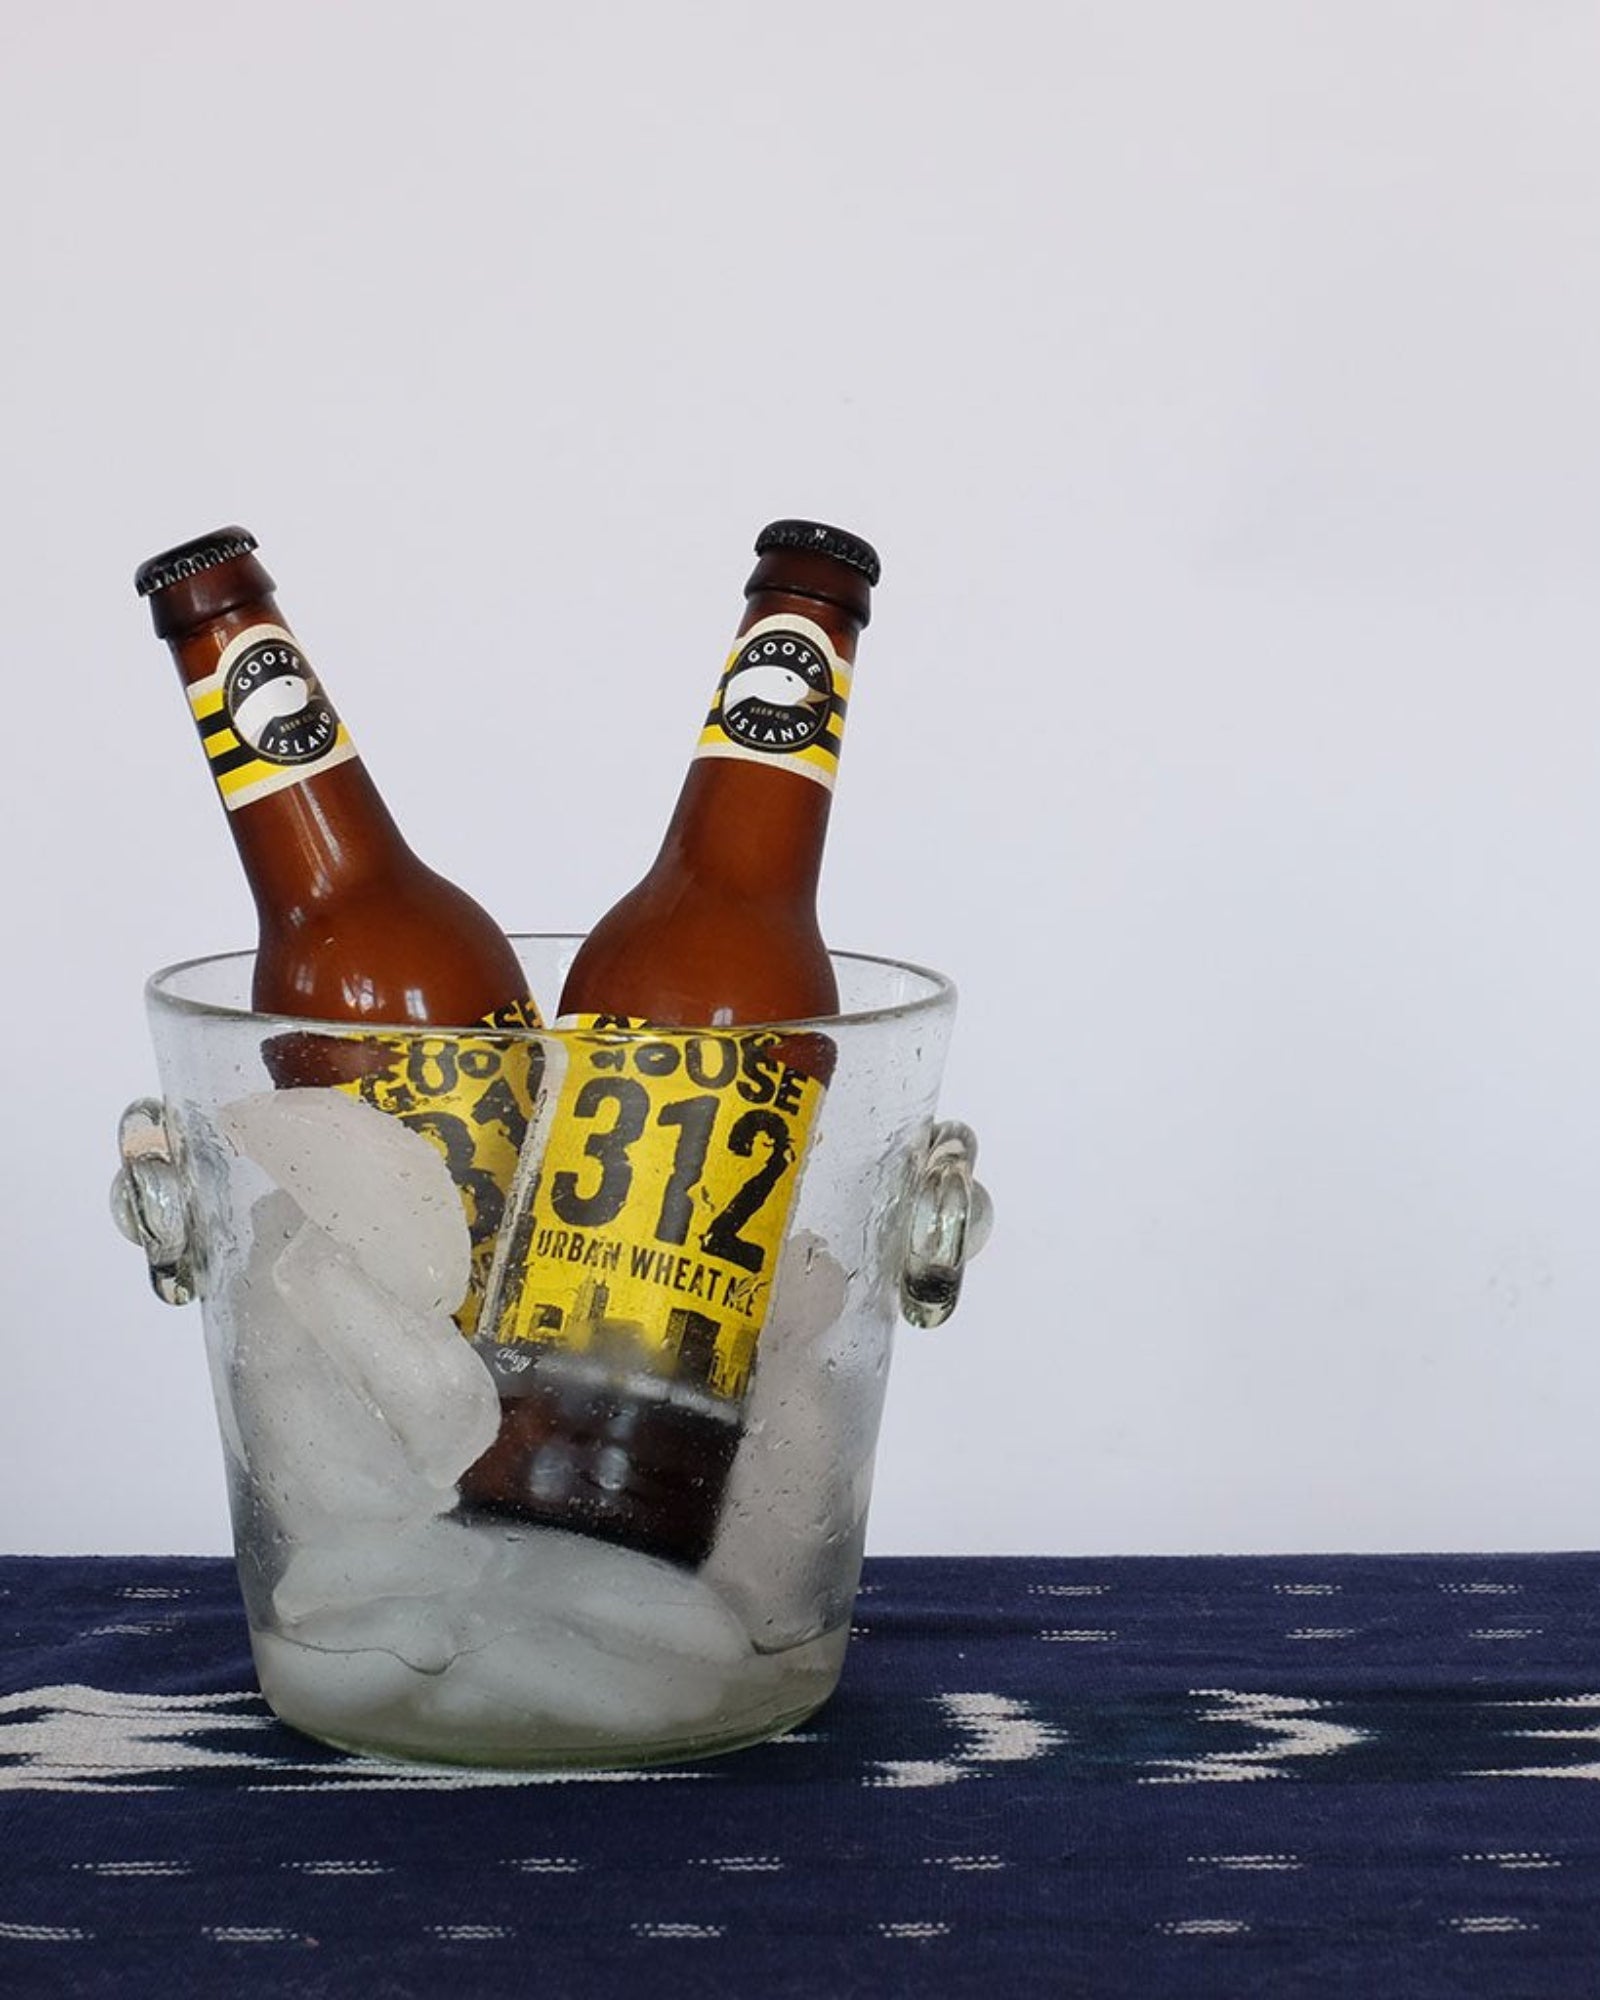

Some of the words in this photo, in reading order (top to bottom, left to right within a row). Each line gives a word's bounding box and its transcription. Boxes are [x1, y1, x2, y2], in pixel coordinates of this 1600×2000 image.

[238, 650, 299, 690] GOOSE
[748, 642, 820, 676] GOOSE
[267, 711, 331, 753] ISLAND
[730, 711, 808, 742] ISLAND
[551, 1076, 795, 1273] 312
[537, 1229, 622, 1272] URBAN
[630, 1245, 721, 1301] WHEAT
